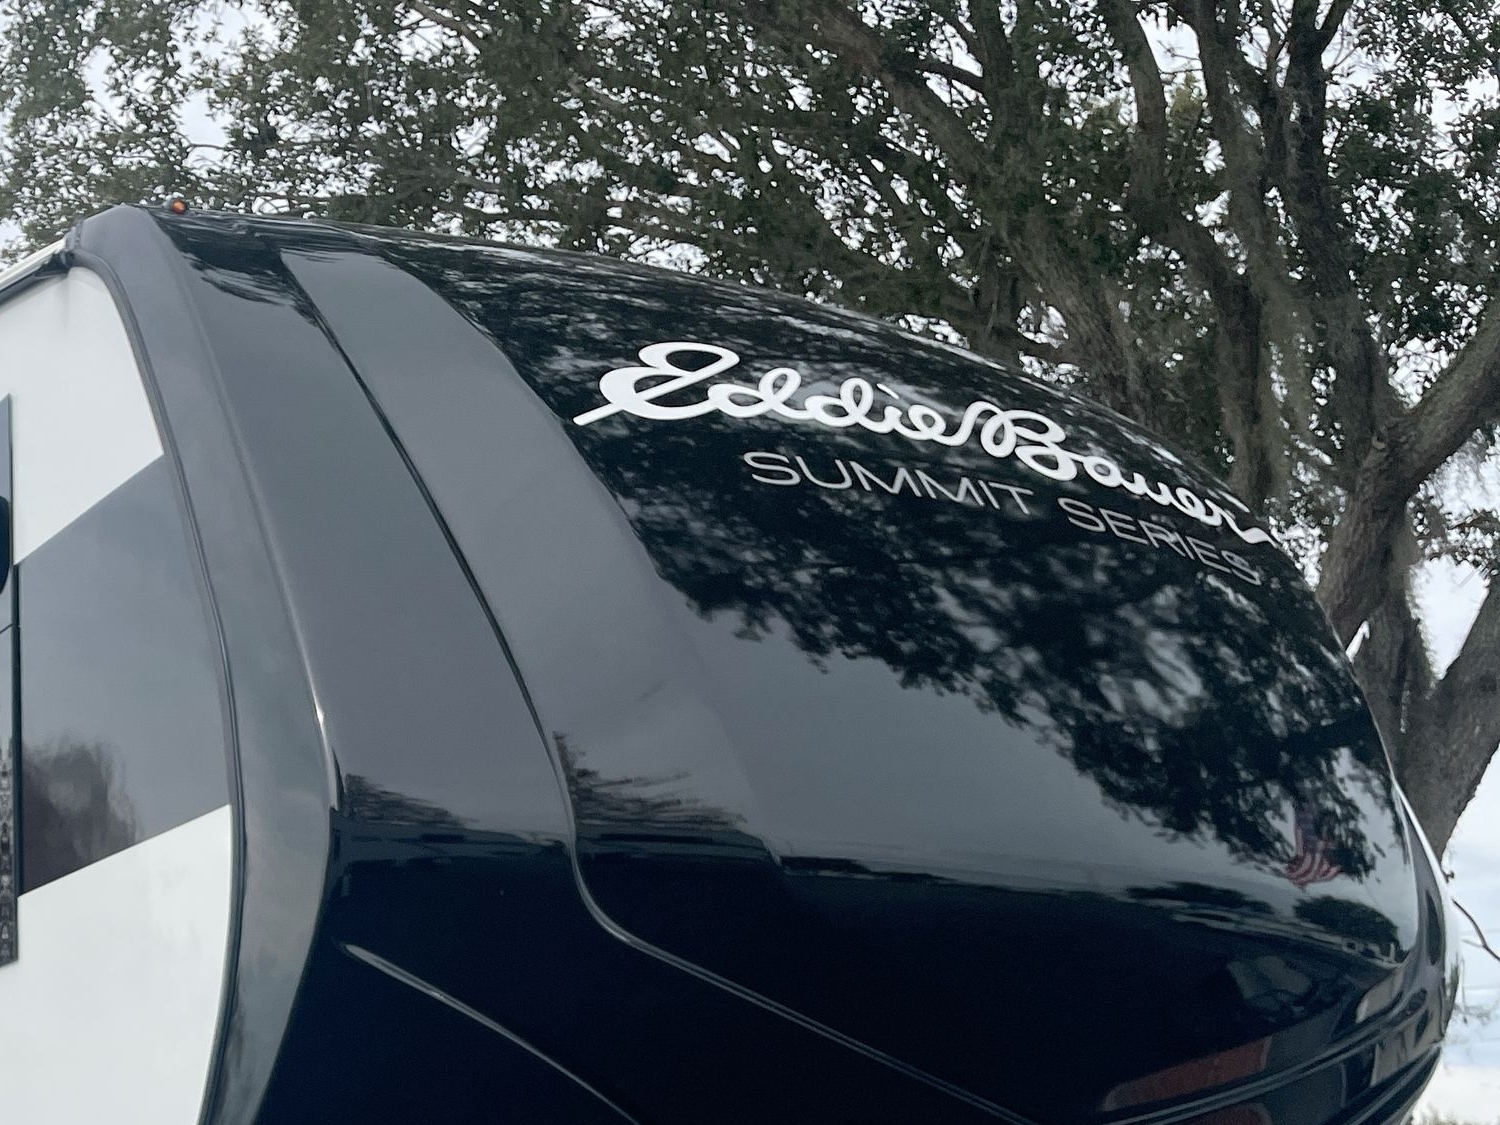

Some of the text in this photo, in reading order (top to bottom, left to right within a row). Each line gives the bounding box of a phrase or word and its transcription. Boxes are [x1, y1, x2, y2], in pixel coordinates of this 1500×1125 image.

[573, 341, 1280, 550] Eddie Bauer
[743, 451, 1262, 586] SUMMIT SERIES
